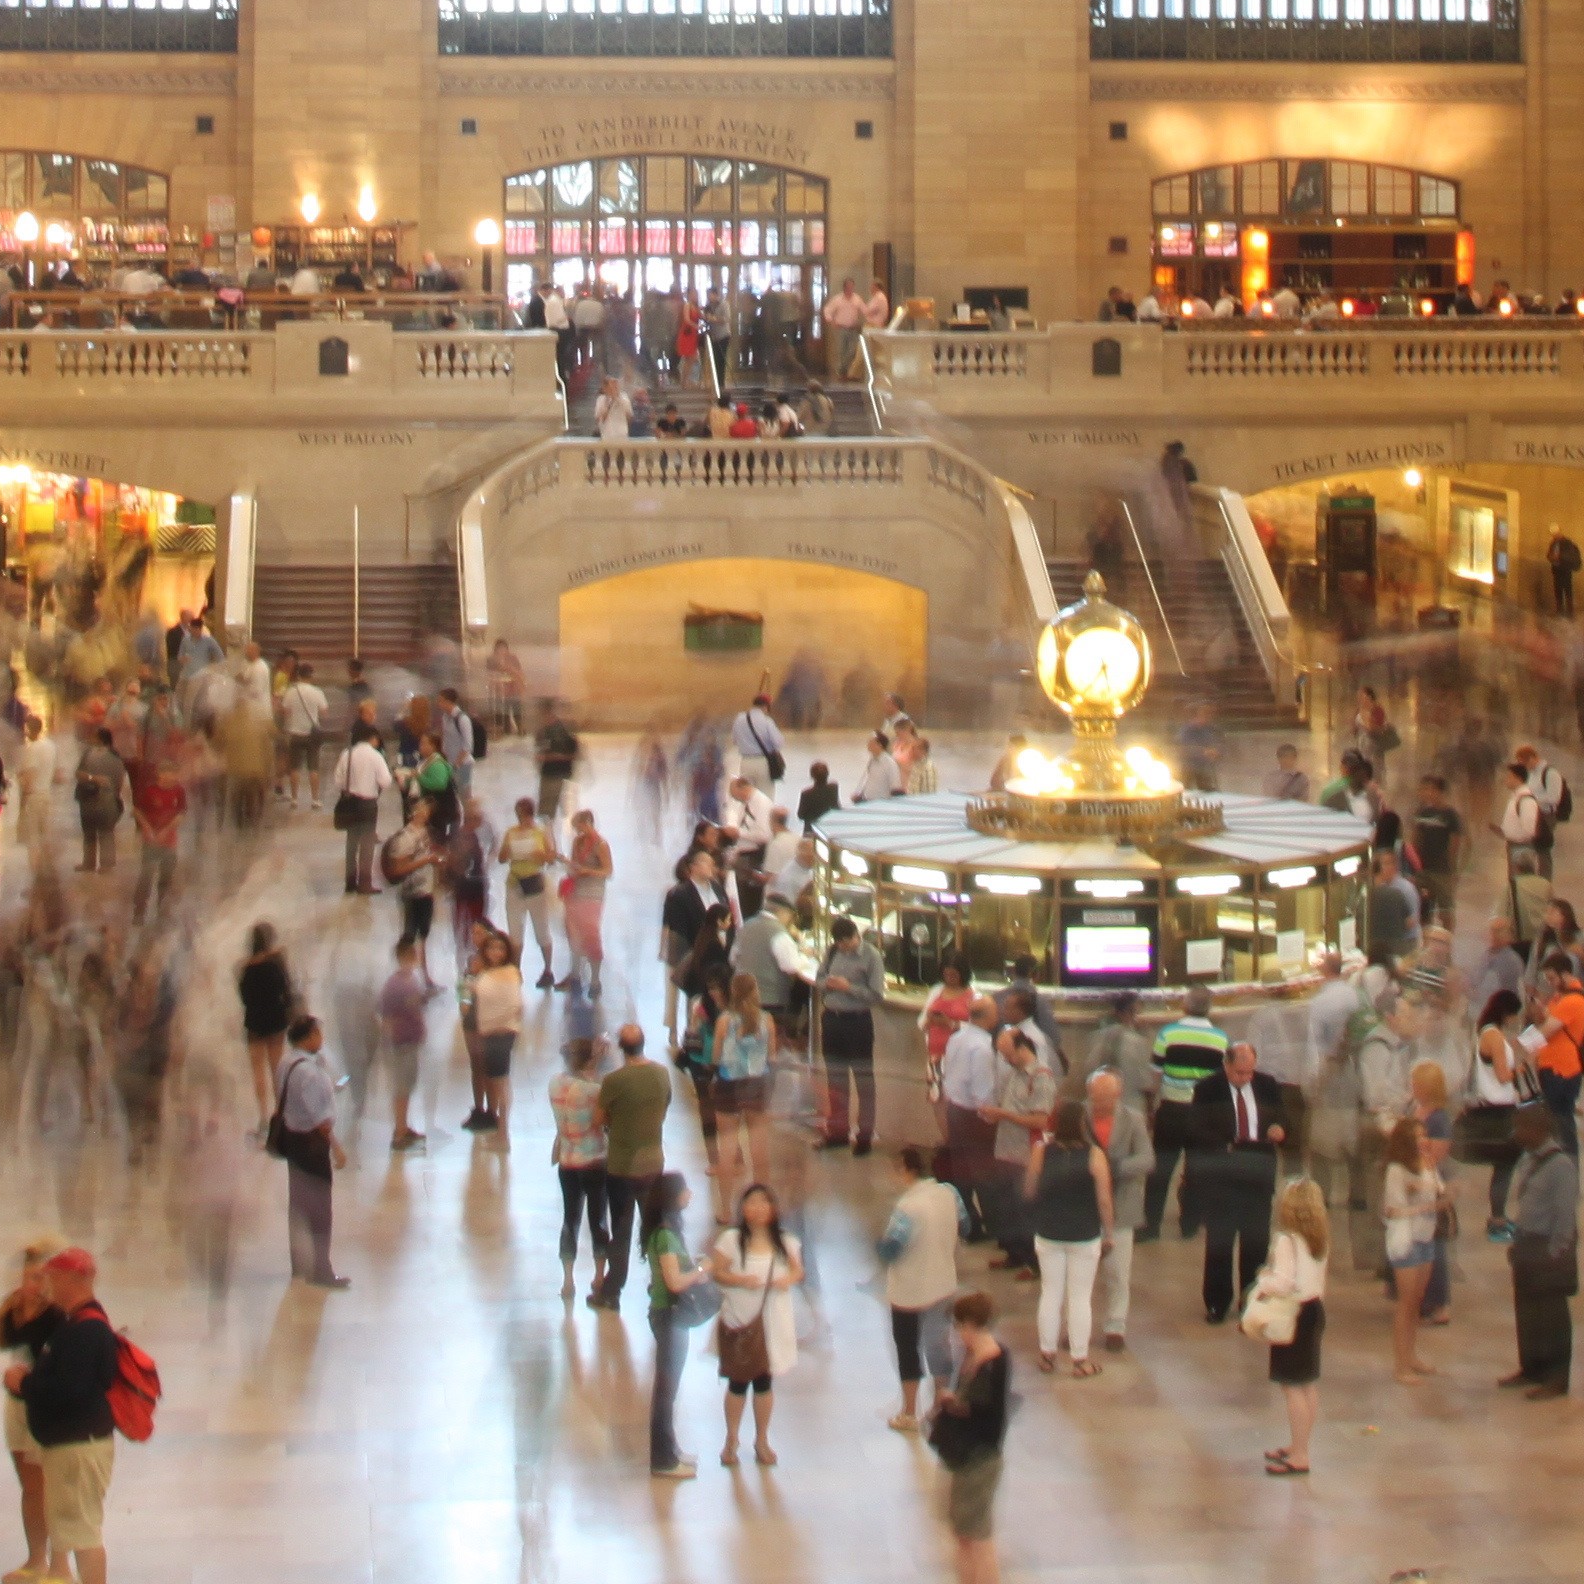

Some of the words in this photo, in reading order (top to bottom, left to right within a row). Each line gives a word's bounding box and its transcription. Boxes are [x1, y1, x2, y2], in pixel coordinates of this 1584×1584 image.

[576, 116, 704, 134] VANDERBILT
[718, 119, 796, 142] AVENUE
[524, 143, 565, 162] THE
[575, 133, 678, 152] CAMPBELL
[694, 134, 811, 164] APARTMENT
[298, 432, 337, 445] WEST
[343, 432, 414, 445] BALCONY
[1028, 432, 1066, 444] WEST
[1072, 432, 1140, 445] BALCONY
[34, 448, 111, 473] STREET
[1271, 454, 1338, 479] TICKET
[1345, 442, 1446, 467] MACHINES
[567, 558, 622, 584] DINING
[624, 542, 704, 566] CONCOURSE
[787, 543, 837, 559] TRACKS
[1080, 801, 1161, 816] Information
